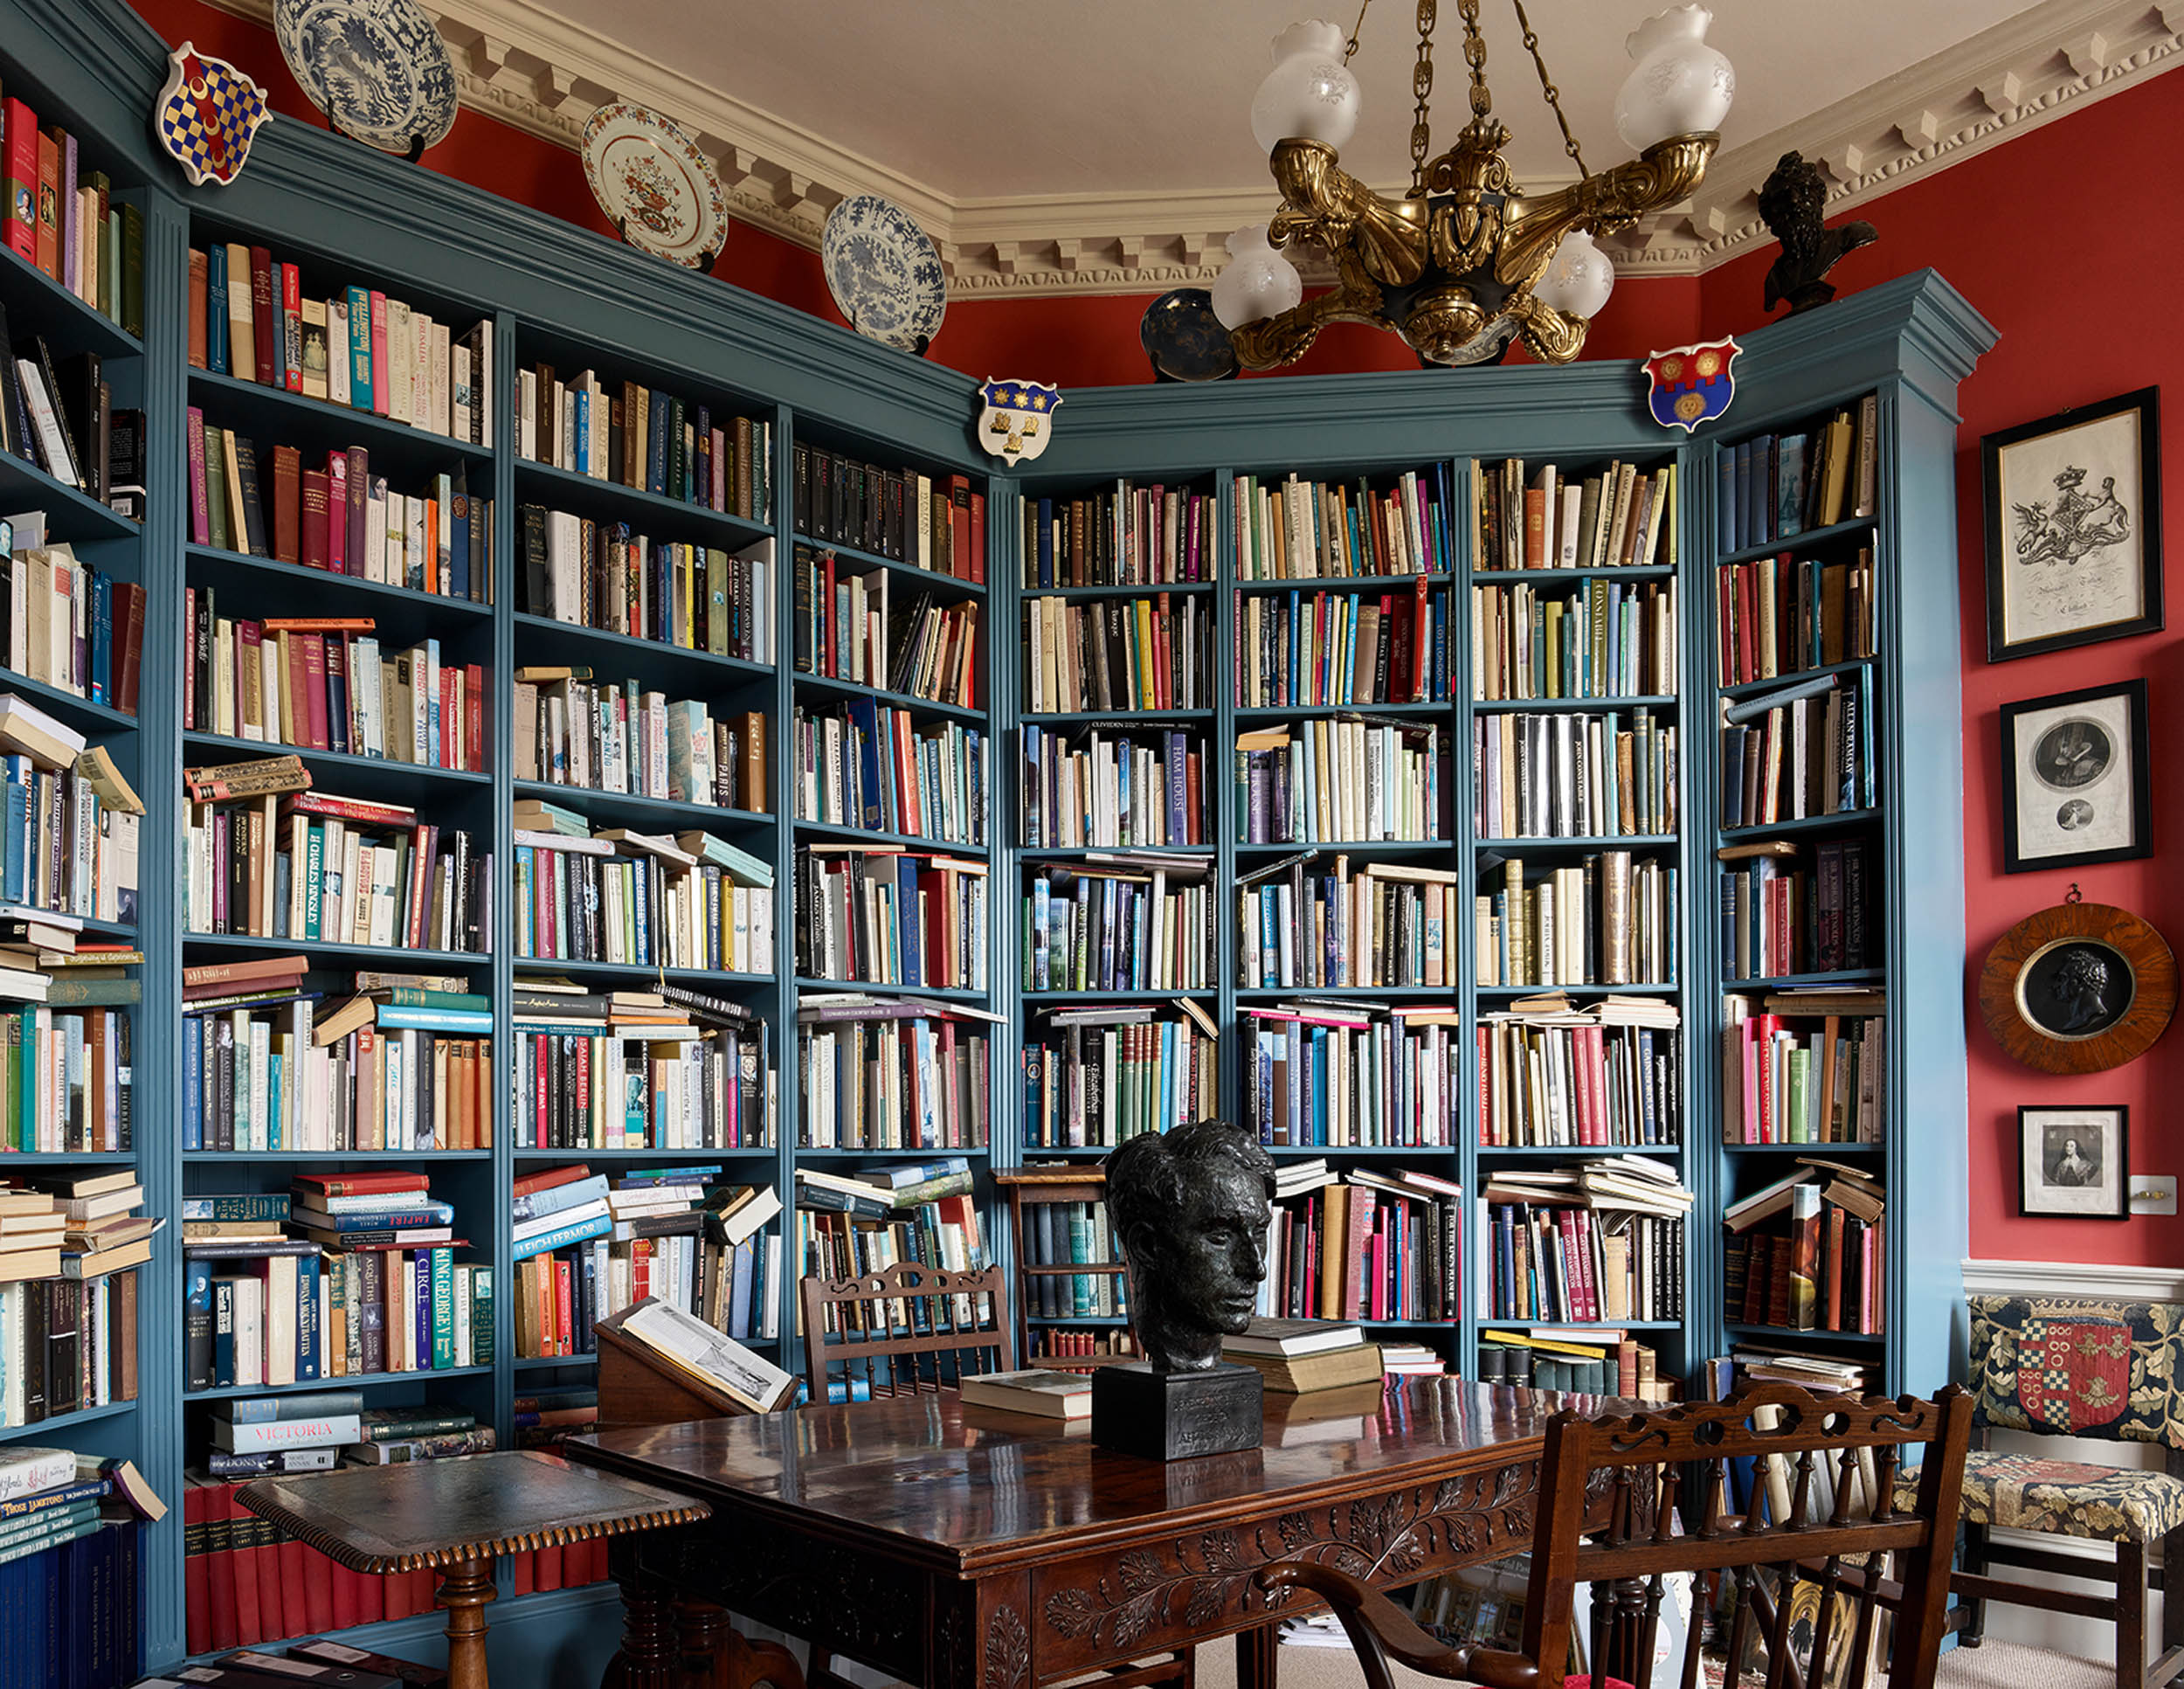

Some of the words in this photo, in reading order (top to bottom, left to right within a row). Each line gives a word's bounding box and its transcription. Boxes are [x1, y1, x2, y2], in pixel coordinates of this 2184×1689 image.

[358, 293, 369, 351] WELLINGTON
[1379, 634, 1389, 658] ROYAL
[1436, 624, 1445, 645] LOST
[1378, 660, 1386, 682] RIVER
[1436, 647, 1445, 683] LONDON
[1844, 701, 1855, 733] ALLAN
[603, 741, 612, 767] ANZIO
[1173, 746, 1183, 773] HAM
[1574, 741, 1584, 758] JOHN
[1844, 735, 1855, 774] RAMSAY
[55, 769, 64, 791] JOHN
[718, 765, 729, 797] PARIS
[1173, 777, 1183, 813] HOUSE
[1250, 773, 1261, 814] HOUSE
[1574, 759, 1584, 803] CONSTABLE
[53, 793, 62, 847] WHITEHURST
[309, 844, 321, 883] CHARLES
[308, 884, 318, 924] KINGSLEY
[812, 884, 822, 915] JAMES
[1830, 876, 1839, 903] JOSHUA
[1852, 873, 1861, 903] JOSHUA
[812, 917, 822, 945] GIBBS
[1830, 907, 1839, 945] REYNOLDS
[1852, 904, 1861, 944] REYNOLDS
[205, 1020, 214, 1047] OSCAR
[205, 1048, 214, 1072] WILDE
[577, 1038, 587, 1073] ISAIAH
[1248, 1048, 1258, 1063] Early
[1090, 1063, 1102, 1115] Elizabethan
[1248, 1064, 1258, 1086] Georgian
[1643, 1049, 1654, 1120] GAINSBOROUGH
[577, 1075, 587, 1109] BERLIN
[57, 1109, 66, 1133] Love
[389, 1214, 430, 1227] EMPIRE
[519, 1236, 552, 1256] LEIGH
[553, 1223, 598, 1246] FERMOR
[365, 1257, 375, 1303] ASQUITHS
[435, 1249, 452, 1279] KING
[1567, 1255, 1576, 1289] HAMILTON
[1581, 1255, 1590, 1290] HAMILTON
[300, 1274, 310, 1304] EDWINA
[417, 1258, 429, 1303] CIRCE
[435, 1280, 452, 1323] GEORGE
[300, 1305, 310, 1357] MOUNTBATTEN
[435, 1324, 452, 1334] V
[256, 1421, 334, 1441] VICTORIA
